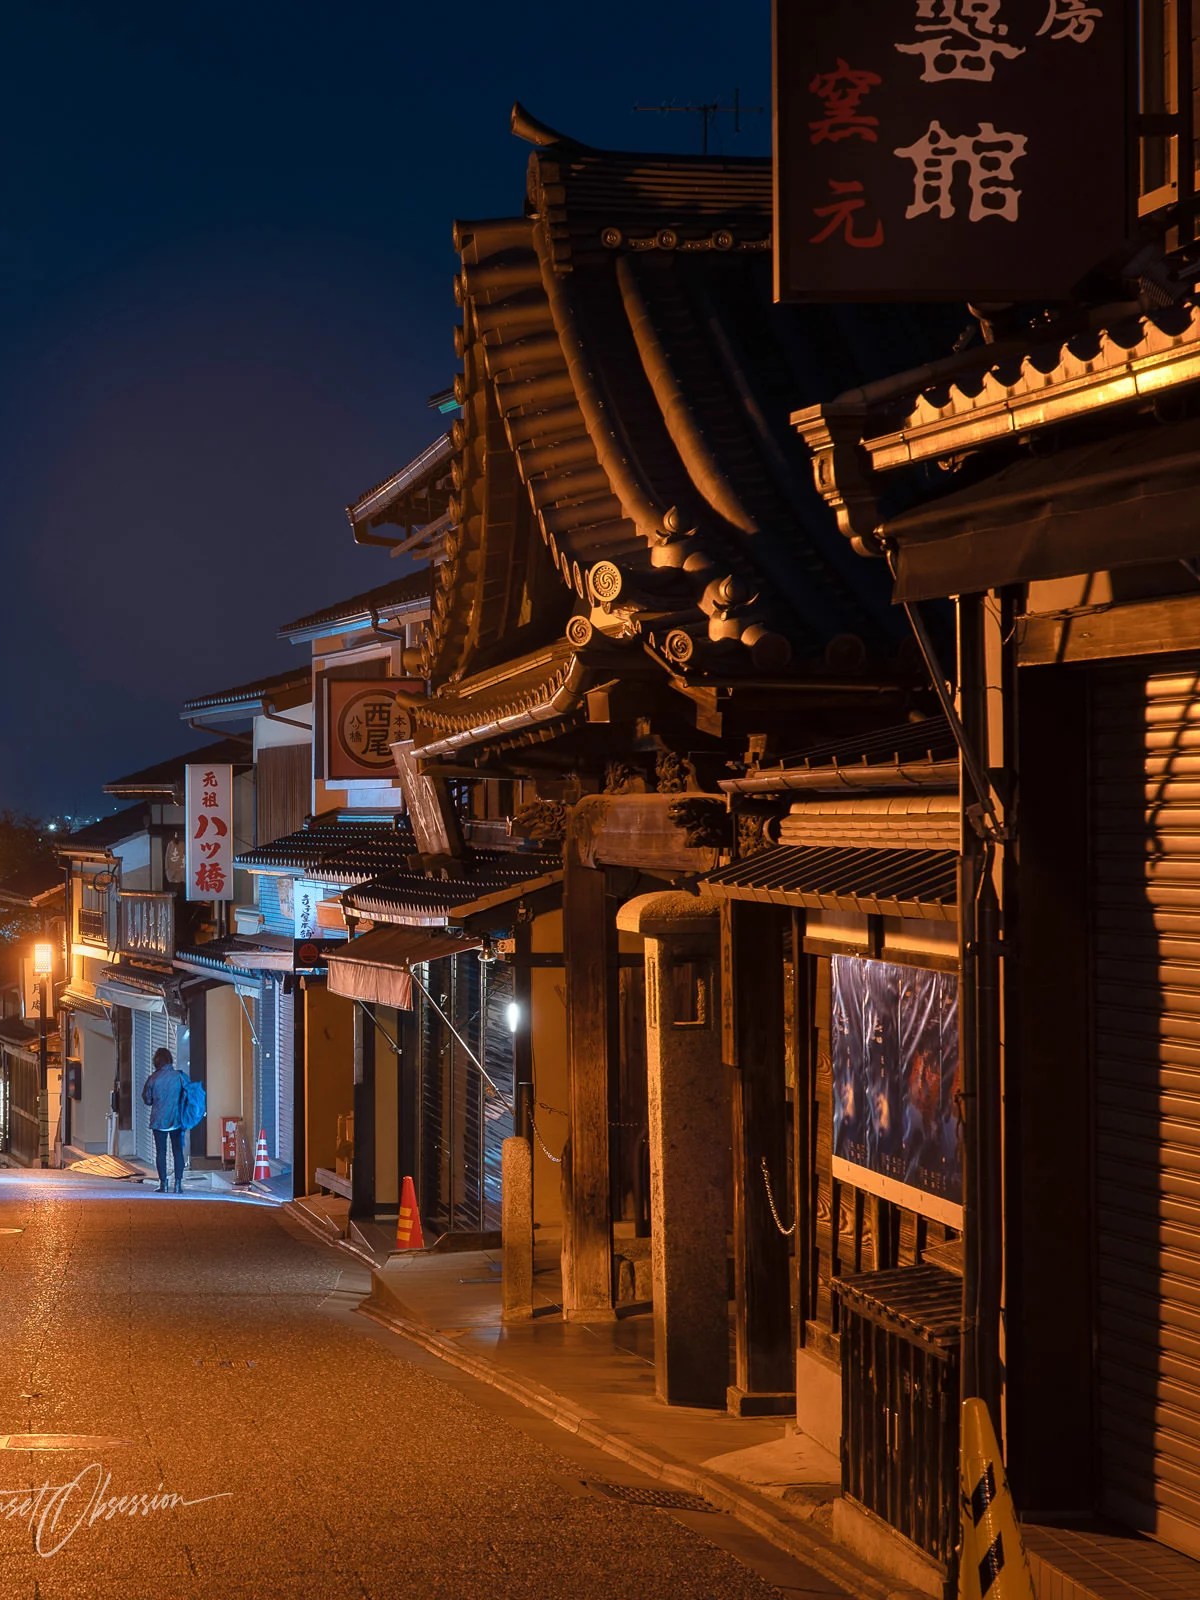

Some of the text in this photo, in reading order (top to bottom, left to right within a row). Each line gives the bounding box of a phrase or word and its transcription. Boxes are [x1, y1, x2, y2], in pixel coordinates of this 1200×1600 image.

[807, 57, 885, 249] 窯元
[361, 701, 392, 757] 西尾
[202, 771, 219, 808] 元祖
